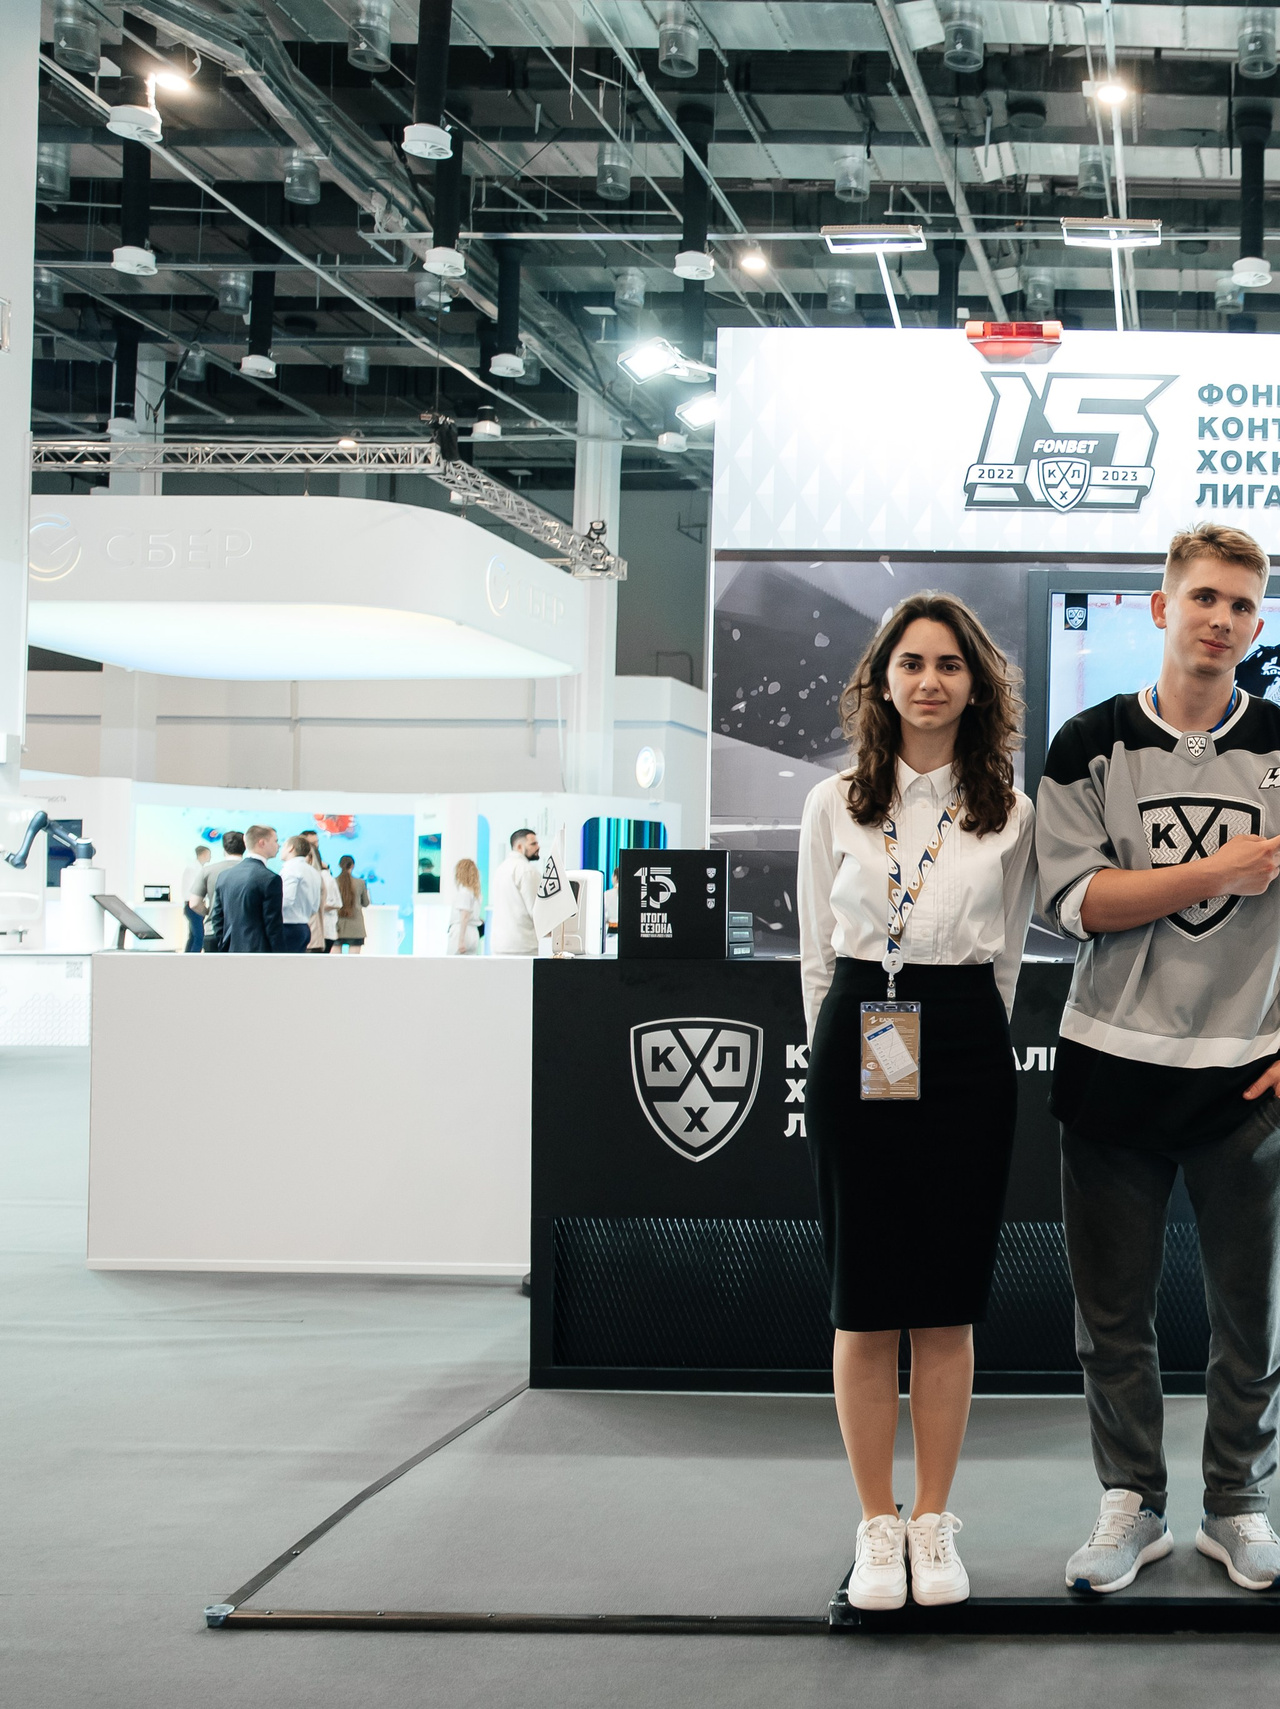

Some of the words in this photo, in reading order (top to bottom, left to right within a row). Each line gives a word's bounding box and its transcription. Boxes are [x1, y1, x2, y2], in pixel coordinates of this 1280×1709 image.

[1032, 439, 1099, 454] FONBET
[977, 468, 1014, 479] 2022
[1101, 471, 1138, 481] 2023
[105, 528, 253, 569] СБЕР
[634, 867, 676, 909] 15
[640, 912, 668, 923] ИТОГИ
[640, 923, 673, 934] СЕЗОНА
